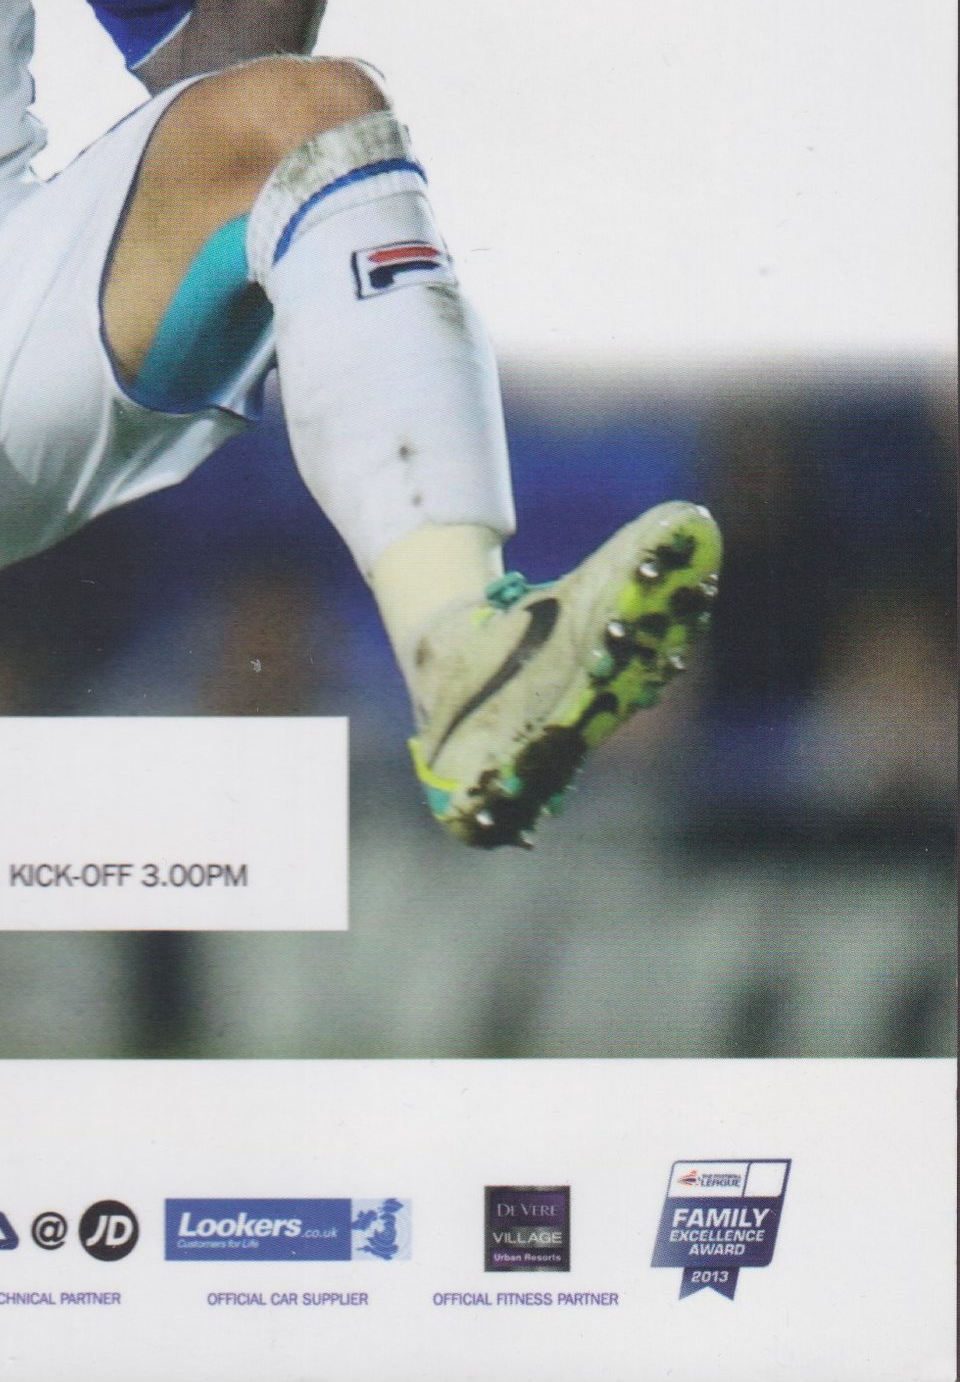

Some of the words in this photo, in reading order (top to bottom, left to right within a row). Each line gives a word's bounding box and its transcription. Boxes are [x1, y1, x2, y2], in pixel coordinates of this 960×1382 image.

[8, 862, 132, 888] KICK-OFF
[140, 862, 248, 888] 3.00PM
[701, 1178, 740, 1187] LEAGUE
[520, 1203, 558, 1217] VERE
[672, 1208, 769, 1227] FAMILY
[31, 1211, 69, 1250] @
[85, 1213, 134, 1247] JD
[670, 1229, 765, 1242] EXCELLENCE
[176, 1239, 226, 1249] Customers
[227, 1239, 242, 1248] for
[242, 1239, 259, 1249] Life
[492, 1232, 562, 1245] VILLAGE
[689, 1243, 745, 1256] AWARD
[493, 1253, 521, 1261] Urban
[524, 1253, 561, 1261] Resorts
[691, 1270, 728, 1283] 2013
[60, 1292, 122, 1305] PARTNER
[207, 1293, 267, 1306] OFFICIAL
[270, 1293, 298, 1306] CAR
[302, 1293, 369, 1306] SUPPLIER
[433, 1292, 493, 1306] OFFICIAL
[497, 1292, 553, 1306] FITNESS
[557, 1292, 619, 1306] PARTNER
